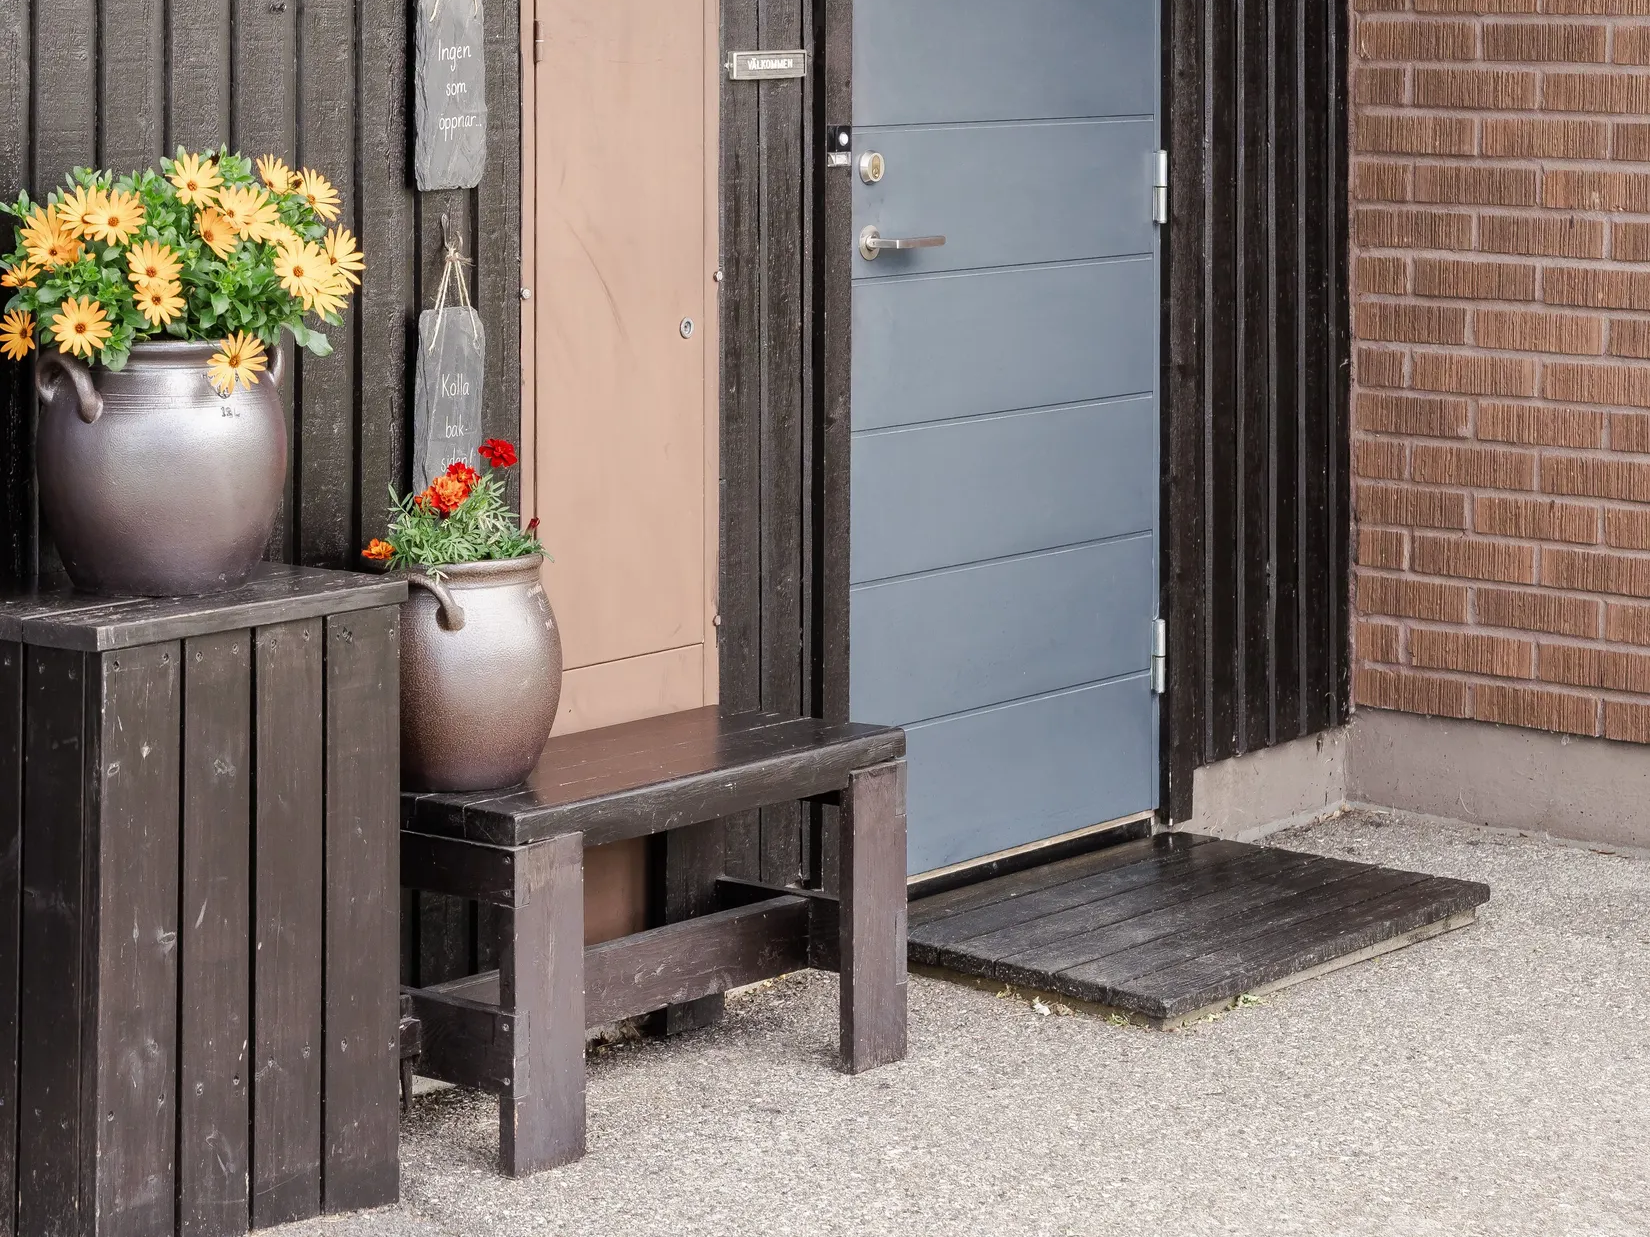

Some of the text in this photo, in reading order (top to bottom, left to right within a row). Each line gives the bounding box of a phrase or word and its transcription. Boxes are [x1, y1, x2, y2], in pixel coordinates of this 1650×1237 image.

[438, 39, 472, 72] Ingen
[747, 58, 793, 70] VÄLKOMMEN
[445, 82, 467, 96] som
[441, 373, 470, 398] Kolla
